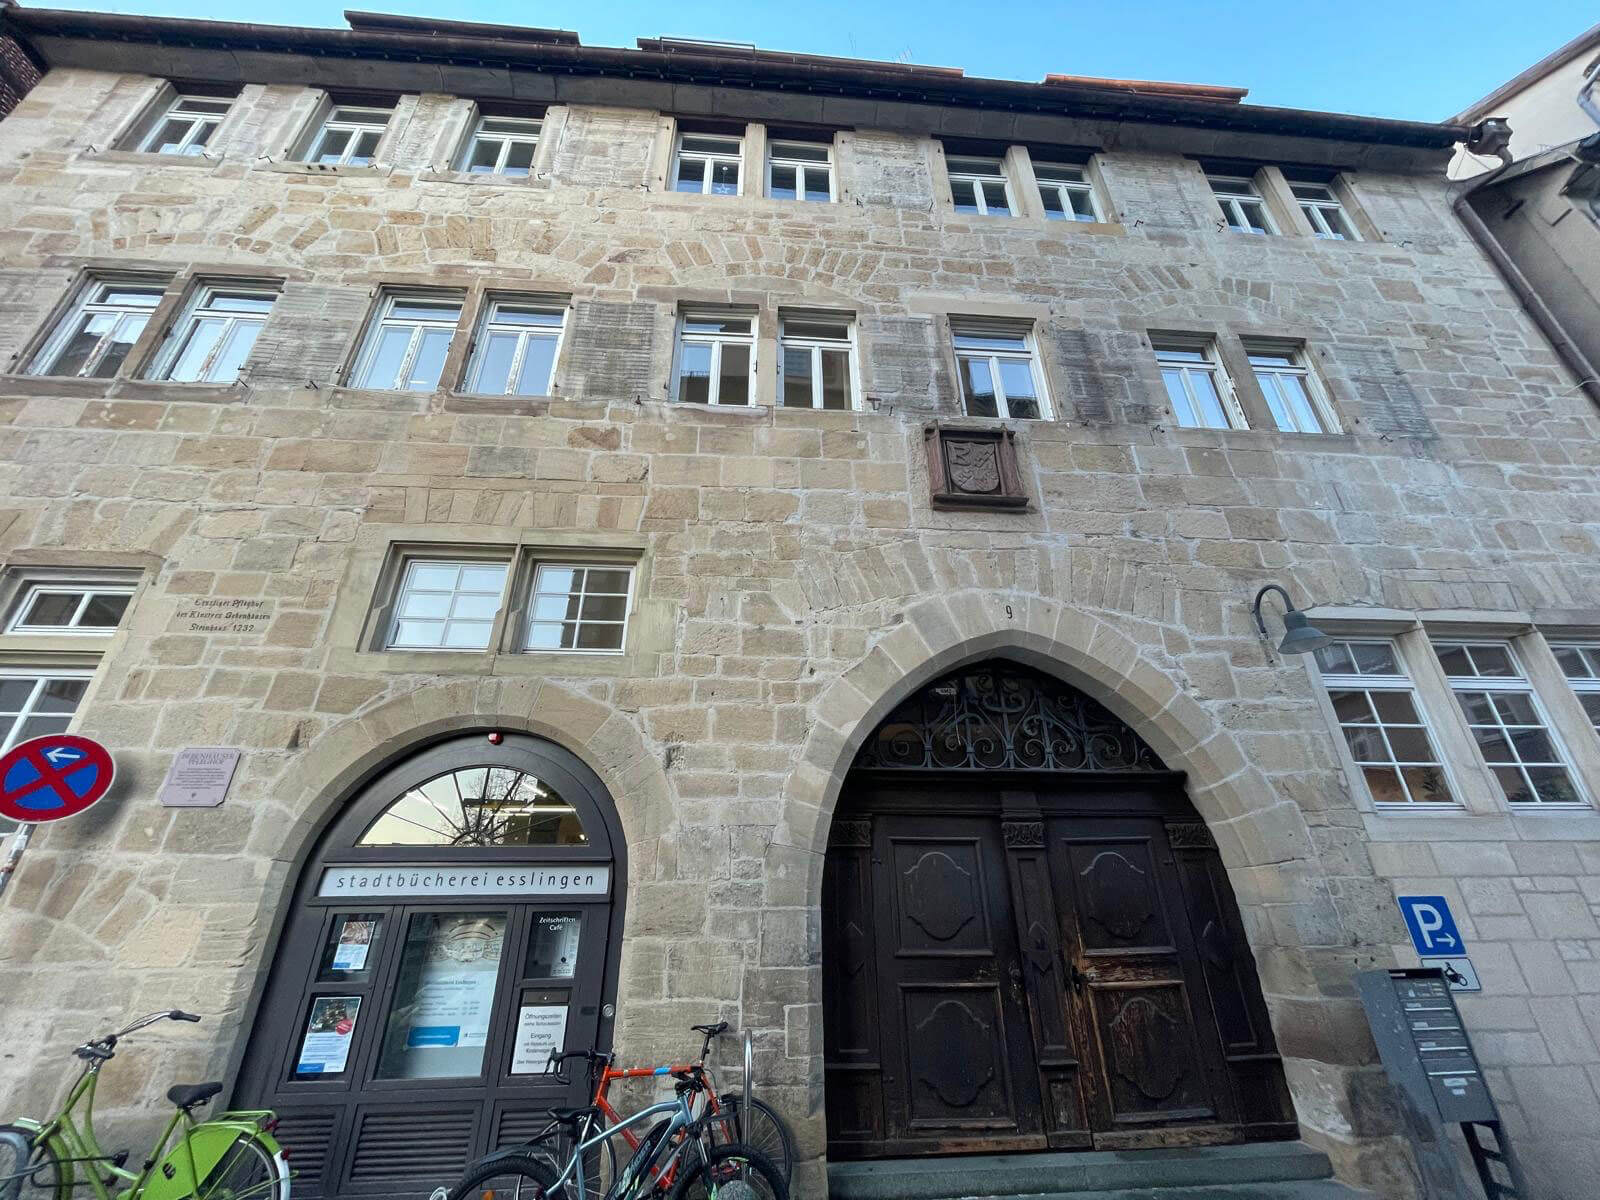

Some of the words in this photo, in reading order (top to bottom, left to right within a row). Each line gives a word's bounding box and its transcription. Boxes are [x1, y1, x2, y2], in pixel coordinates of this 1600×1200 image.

[232, 599, 264, 609] Pfleghof
[1006, 605, 1013, 619] 9
[336, 872, 489, 889] stadtbücherei
[496, 871, 594, 890] esslingen
[1411, 903, 1443, 949] P
[530, 1032, 552, 1040] Eingang
